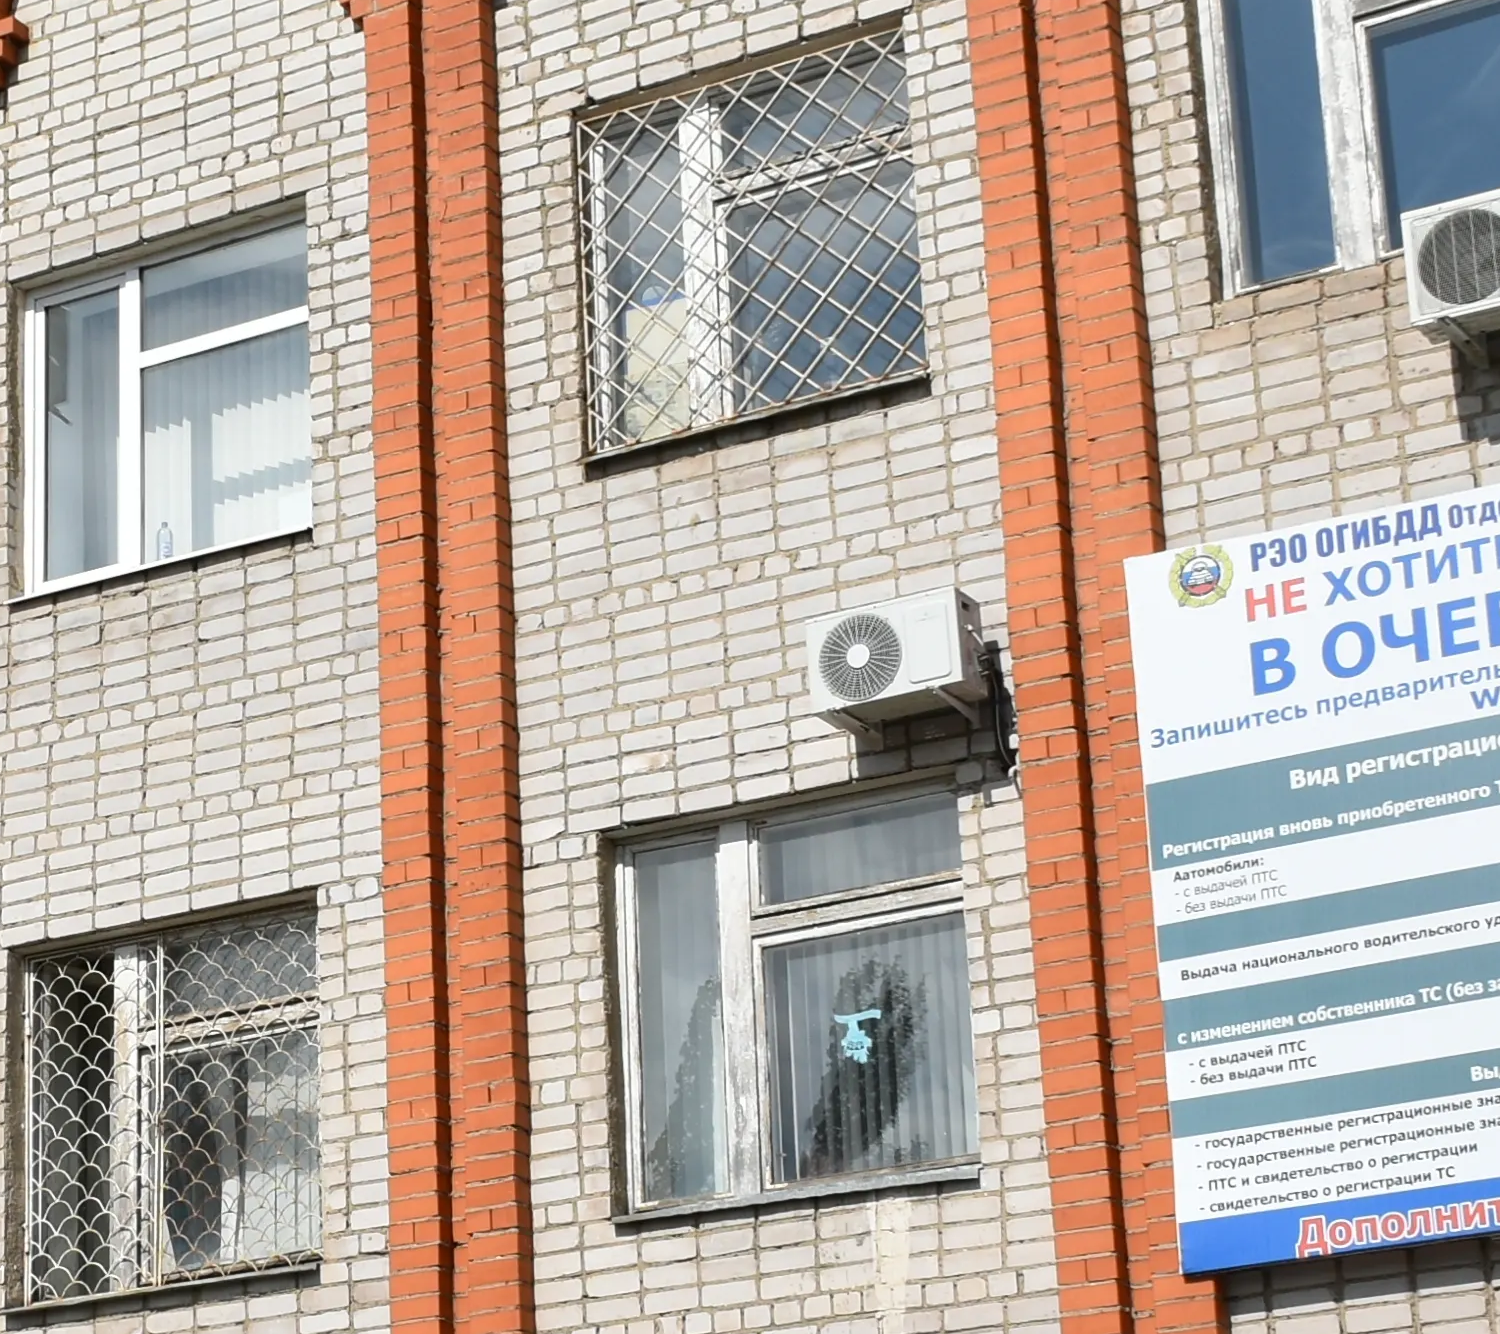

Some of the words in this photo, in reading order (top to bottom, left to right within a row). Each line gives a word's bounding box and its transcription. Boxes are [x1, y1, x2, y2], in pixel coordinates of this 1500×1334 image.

[1250, 533, 1307, 572] РЭО
[1315, 503, 1442, 558] ОГИБДД
[1245, 577, 1307, 622] НЕ
[1249, 638, 1296, 696] В
[1150, 704, 1308, 748] Запишитесь
[1289, 766, 1340, 790] Вид
[1162, 827, 1275, 859] Регистрация
[1279, 816, 1333, 836] вновь
[1337, 786, 1491, 826] приобретенного
[1205, 1122, 1333, 1149] государственные
[1338, 1099, 1472, 1132] регистрационные
